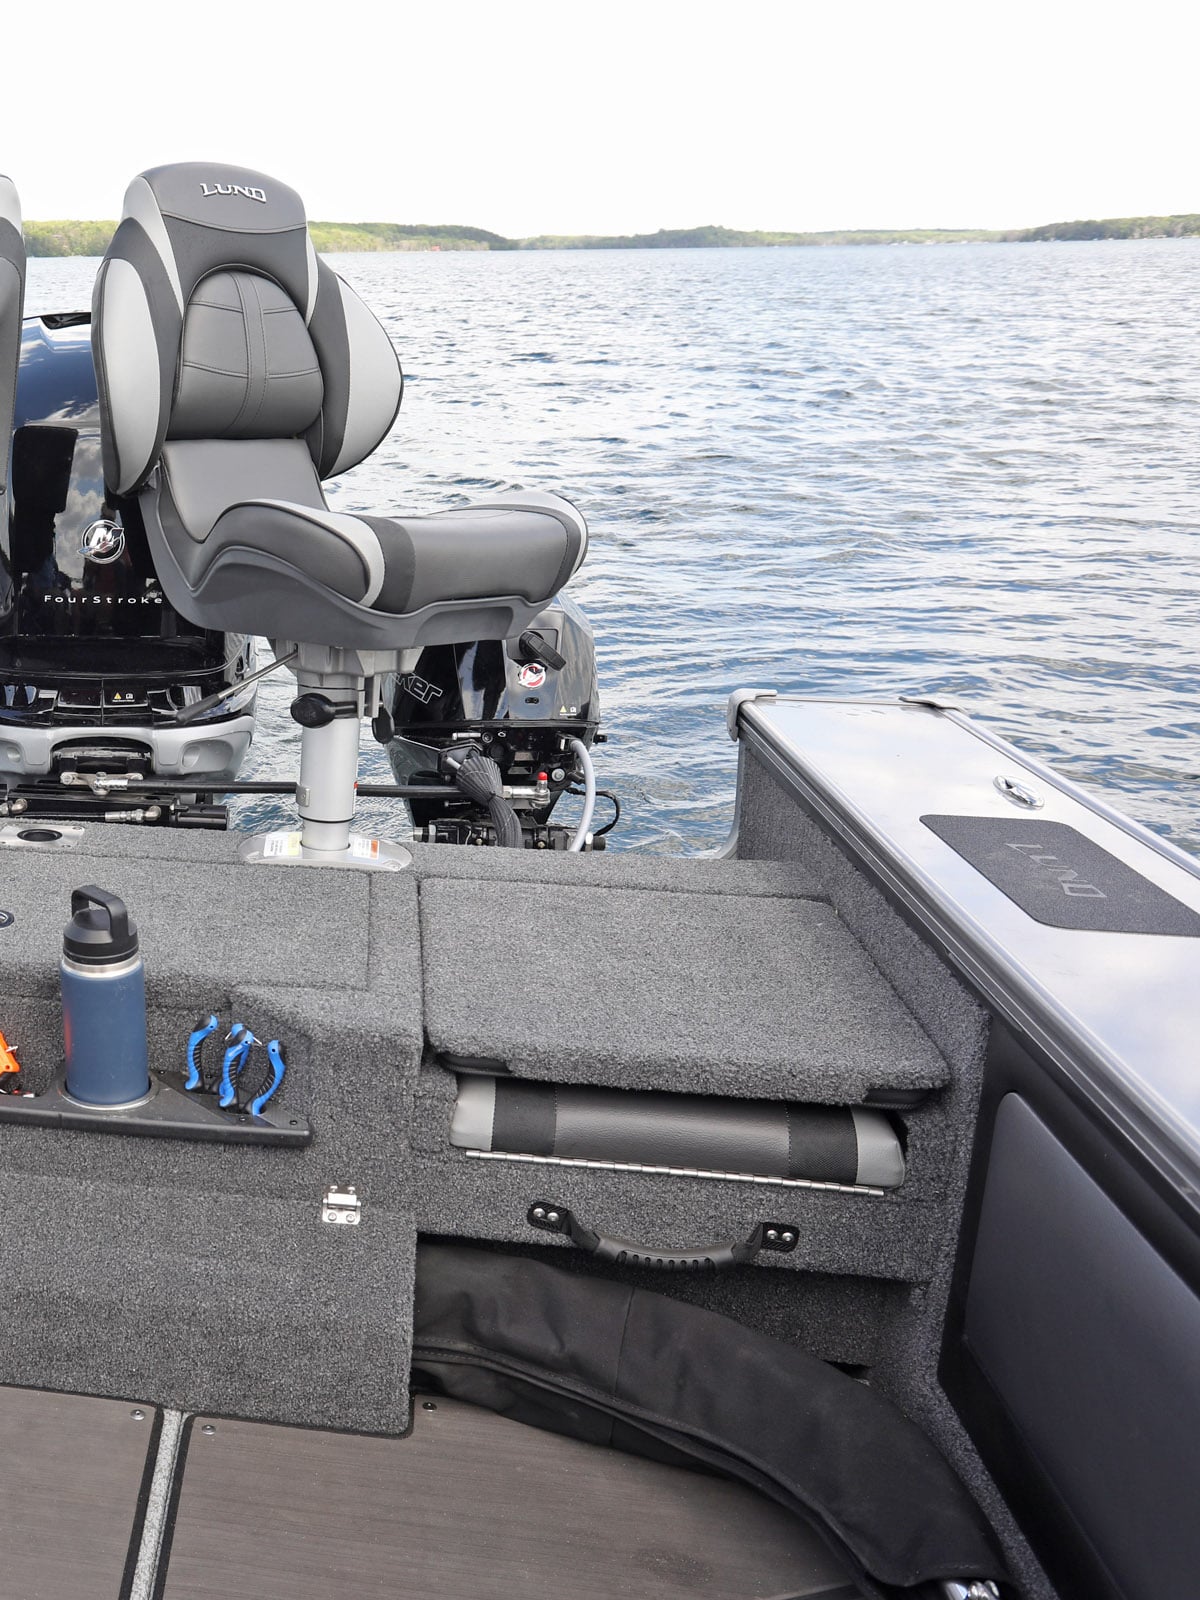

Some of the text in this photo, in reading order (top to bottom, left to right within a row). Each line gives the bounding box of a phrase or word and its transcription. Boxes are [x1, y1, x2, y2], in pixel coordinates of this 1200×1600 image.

[200, 183, 267, 203] LUND
[43, 594, 163, 604] FourStroke
[1004, 843, 1108, 898] LUND
